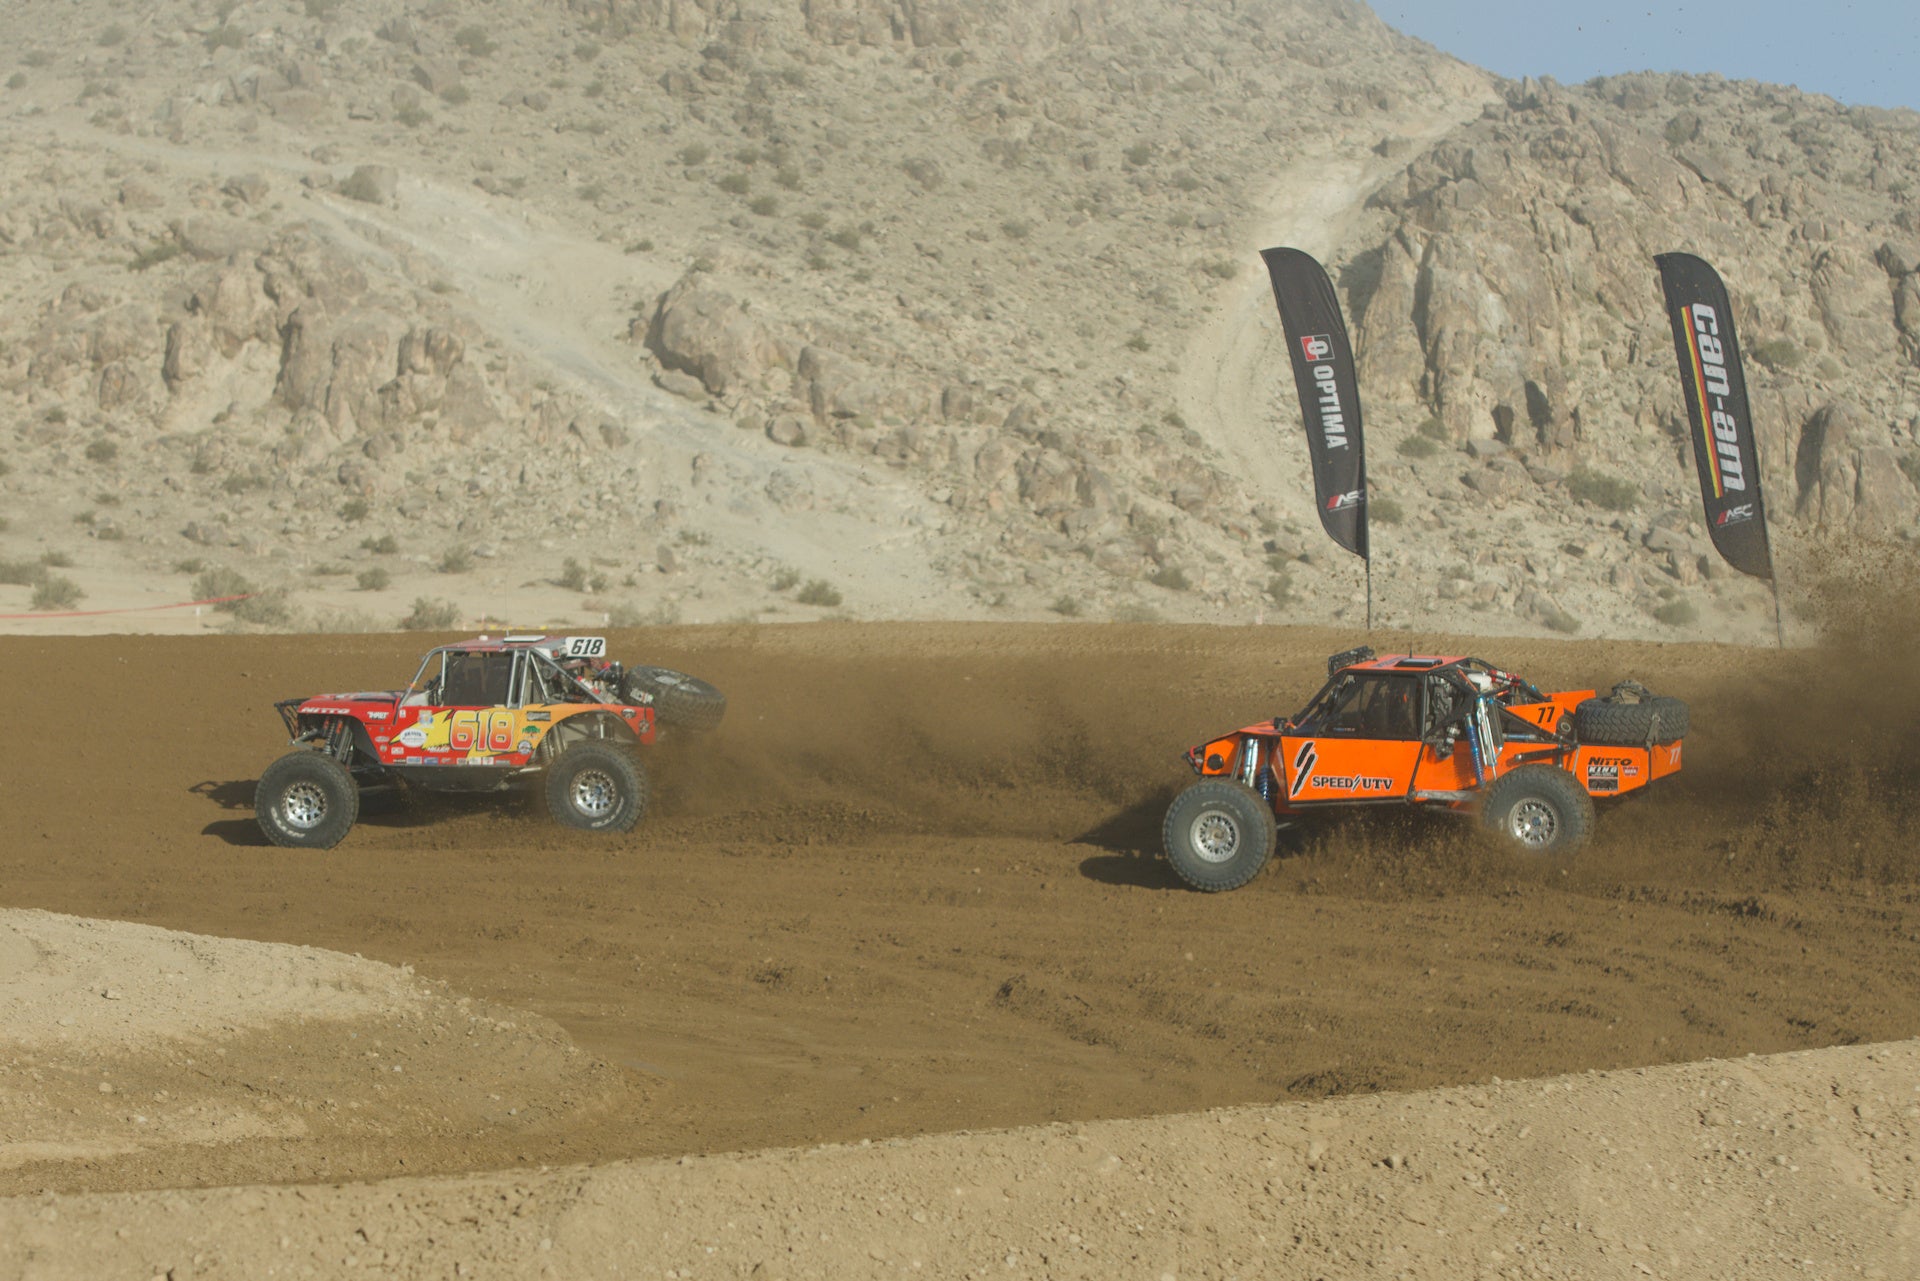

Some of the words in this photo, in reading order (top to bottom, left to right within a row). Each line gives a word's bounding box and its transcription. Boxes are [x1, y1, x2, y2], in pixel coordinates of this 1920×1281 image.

[1692, 302, 1746, 492] can-am
[1313, 364, 1348, 449] OPTIMA
[571, 639, 603, 655] 618
[301, 707, 351, 715] NITTO
[1537, 706, 1555, 724] 77
[450, 710, 514, 751] 618
[1588, 756, 1632, 766] NITTO
[1669, 746, 1681, 765] 77
[1588, 766, 1618, 774] KING
